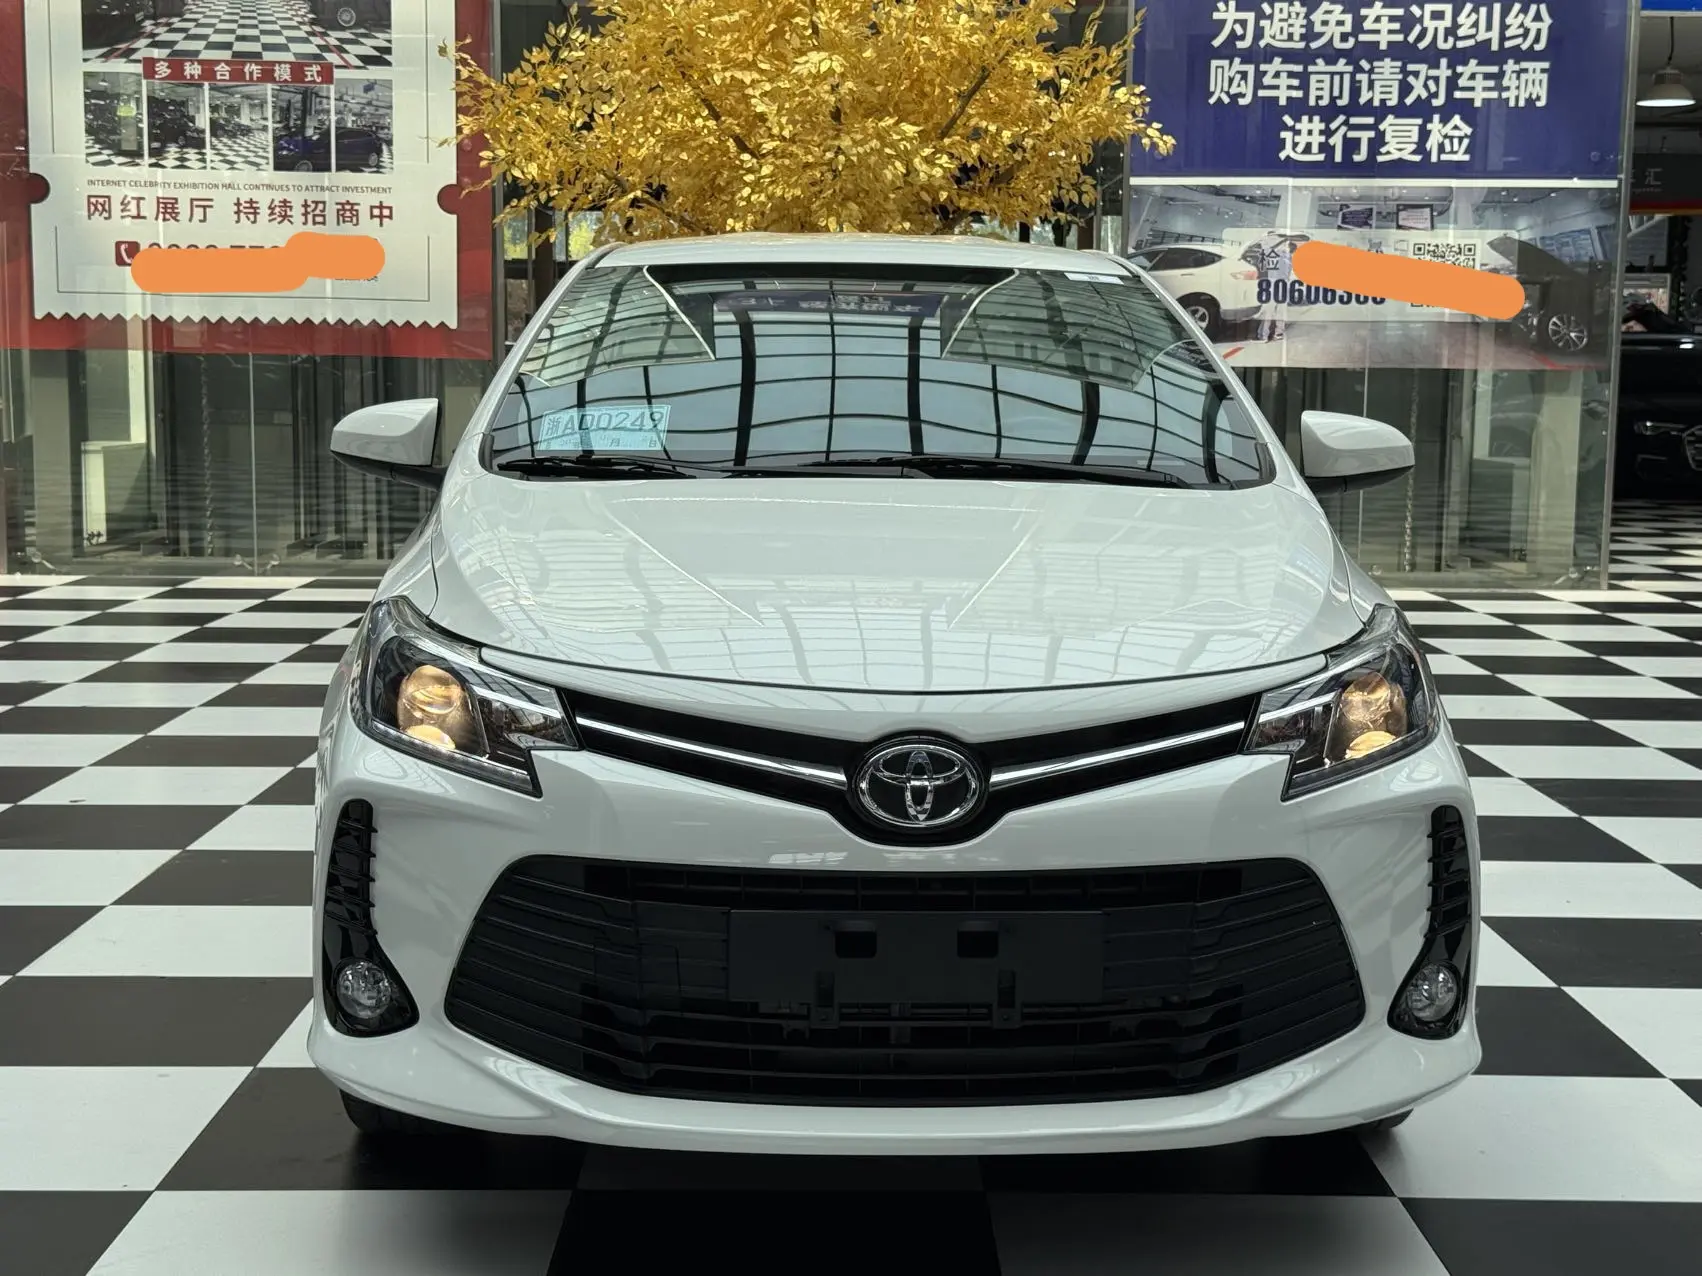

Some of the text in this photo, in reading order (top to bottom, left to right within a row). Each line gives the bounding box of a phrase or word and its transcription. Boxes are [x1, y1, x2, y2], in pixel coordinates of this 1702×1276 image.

[1210, 1, 1553, 51] 为避免车况纠纷
[154, 60, 322, 83] 多种合作模式
[1208, 57, 1551, 107] 购车前请对车辆
[1279, 114, 1473, 163] 进行复检
[87, 179, 392, 194] INTERNET CELEBRITY EXHIBITION HALL CONTINUES TO ATTRACT INVESTMENT
[87, 194, 393, 228] 网红展厅 持续招商中
[1256, 279, 1386, 305] 80606
